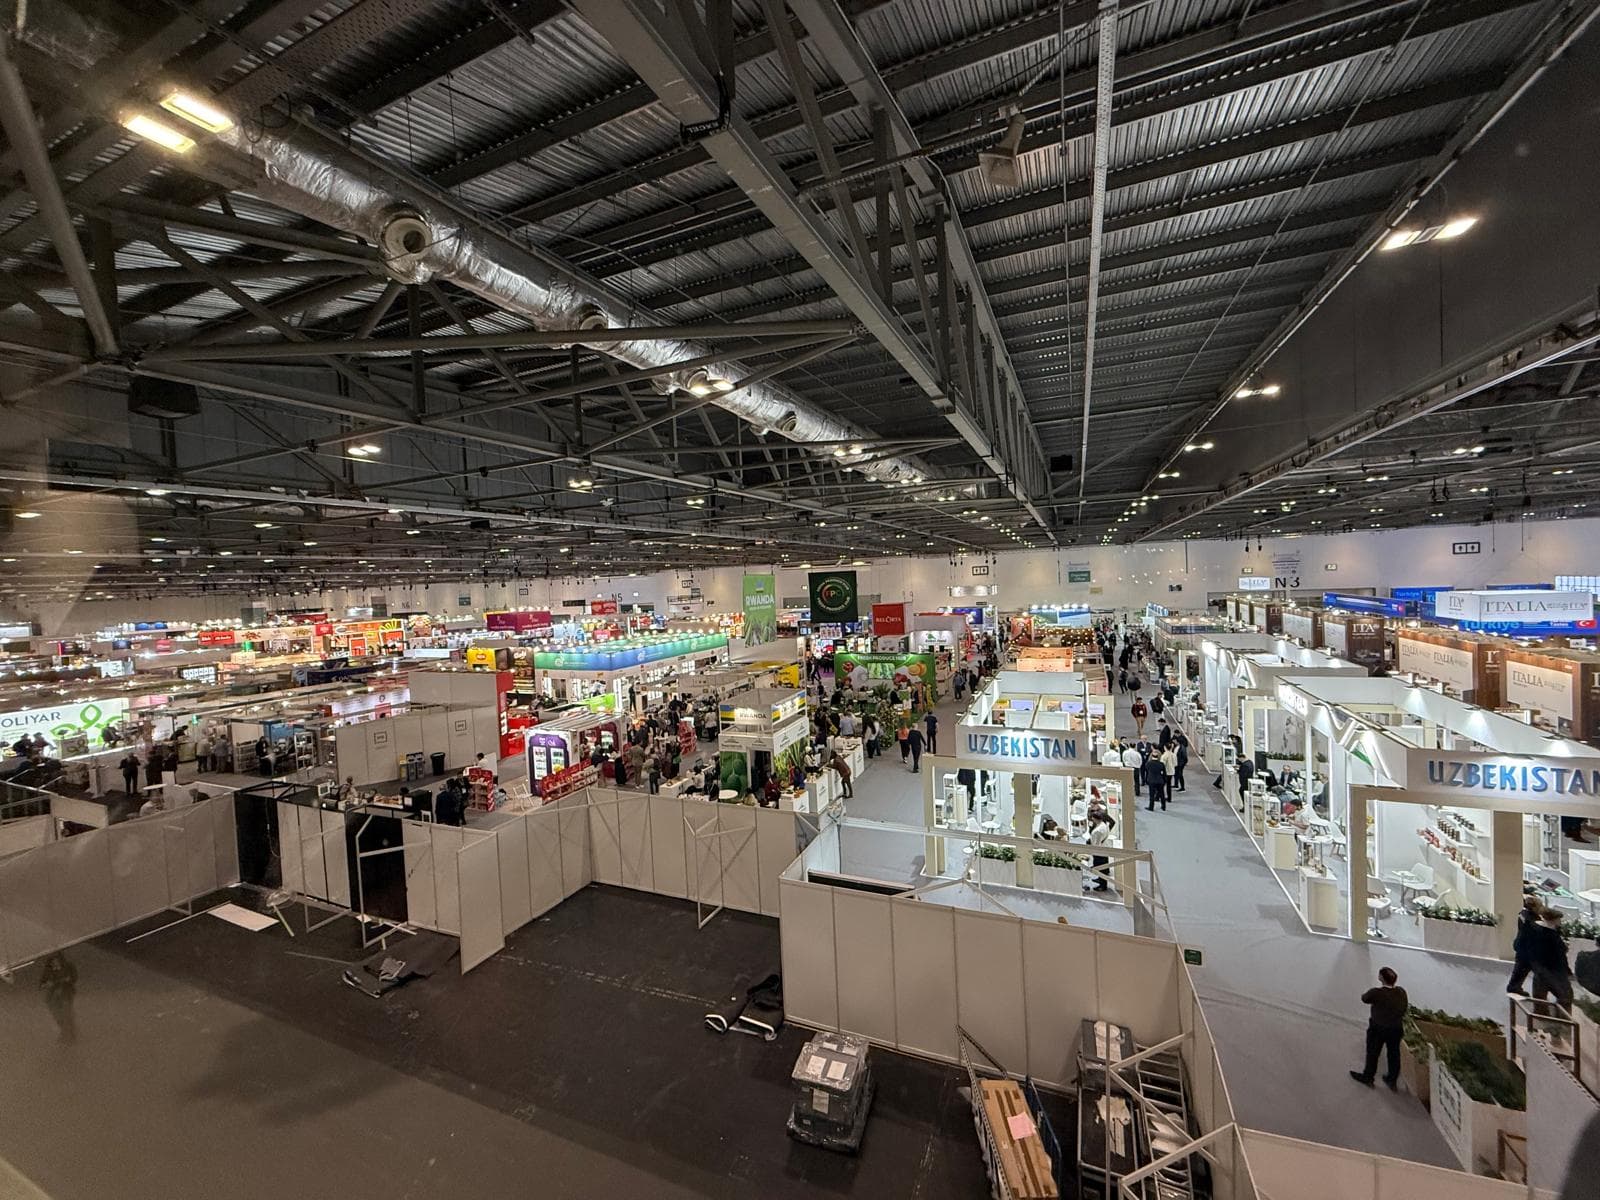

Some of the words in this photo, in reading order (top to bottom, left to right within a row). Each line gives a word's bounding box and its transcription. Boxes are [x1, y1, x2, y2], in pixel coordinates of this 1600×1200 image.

[745, 594, 775, 606] RWANDA
[1485, 601, 1547, 612] ITALIA
[1513, 670, 1544, 687] ITALIA
[1, 712, 61, 728] OLIYAR
[968, 733, 1077, 760] UZBEKISTAN
